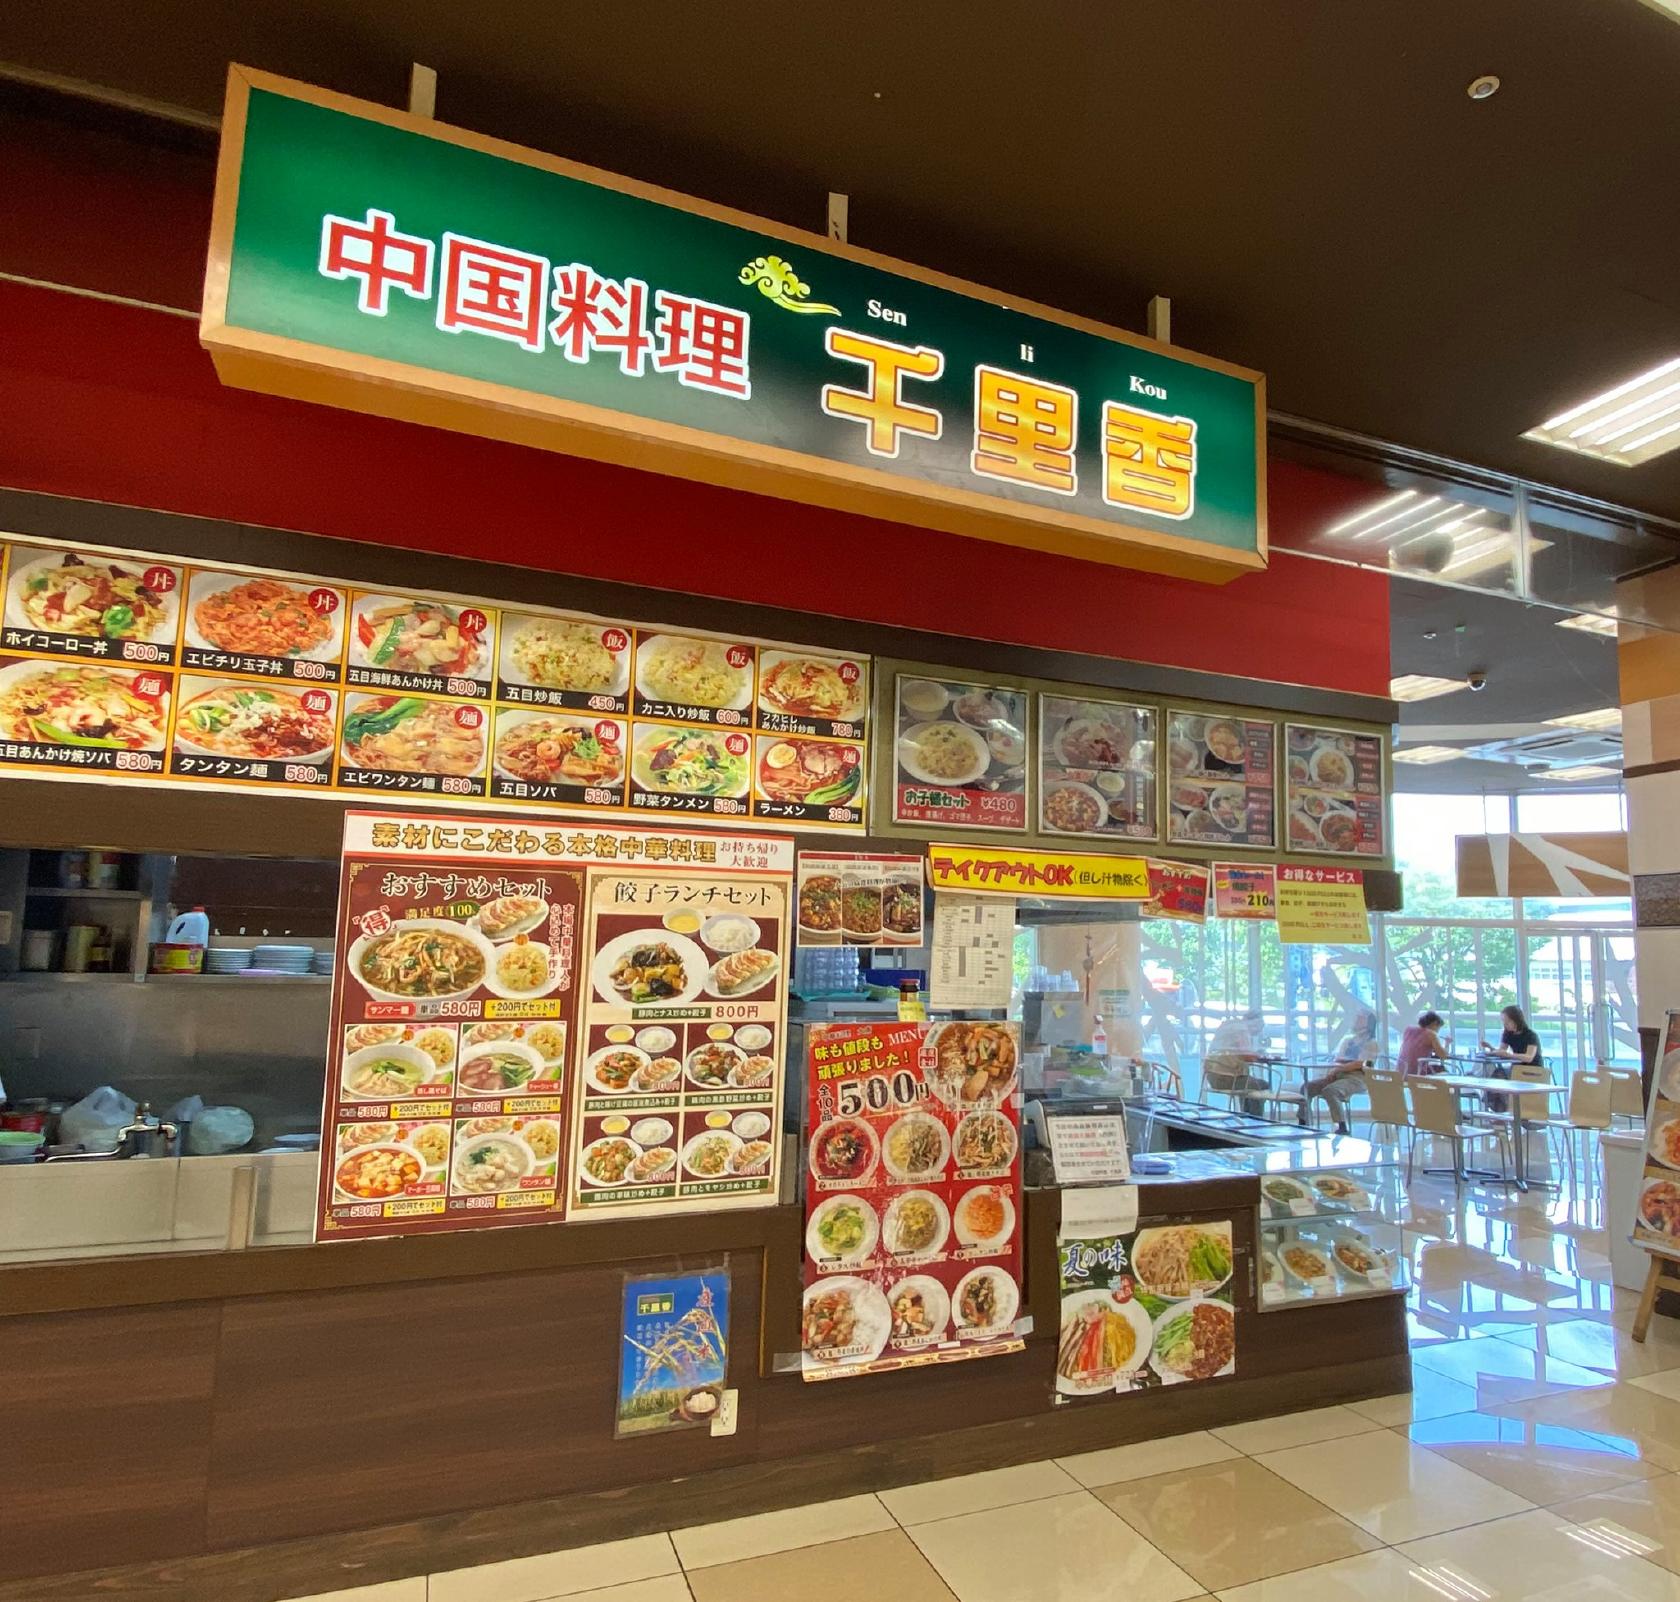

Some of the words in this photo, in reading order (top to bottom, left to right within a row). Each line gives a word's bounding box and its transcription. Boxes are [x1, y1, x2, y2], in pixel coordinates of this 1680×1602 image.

[319, 208, 752, 400] 中国料理
[867, 298, 908, 328] Sen
[1129, 375, 1168, 401] Kou
[822, 327, 1197, 521] 千里香
[152, 570, 174, 590] 丼
[314, 591, 336, 612] 丼
[5, 631, 109, 655] ホイコーロー丼
[122, 643, 171, 663] 500円
[186, 652, 284, 675] エビチリ玉子丼
[293, 660, 337, 681] 500円
[349, 669, 444, 691] 五目海鮮あんかけ丼
[447, 678, 487, 698] 500円
[505, 686, 563, 706] 五目炒飯
[587, 695, 625, 712] 450円
[641, 702, 711, 722] カニ入り炒飯
[716, 709, 749, 726] 600円
[762, 711, 798, 725] フカヒレ
[761, 721, 816, 736] あんかけ炒飯
[116, 752, 163, 770] 580円
[179, 757, 269, 778] タンタン麺
[285, 764, 328, 784] 580円
[344, 771, 436, 790] エビワンタン麺
[442, 778, 482, 794] 580円
[500, 781, 559, 798] 五目ソバ
[584, 787, 621, 805] 580円
[633, 792, 710, 811] 野菜タンメン
[713, 799, 747, 814] 580円
[759, 802, 807, 817] ラーメン
[371, 822, 718, 864] 素材にこだわる本格中華料理
[719, 841, 779, 855] お持ち帰り
[729, 854, 769, 869] 大歓迎
[933, 857, 1075, 886] テイクアウトOK
[380, 871, 553, 901] おすすめセット
[1282, 868, 1356, 883] お得なサービス
[614, 881, 772, 907] 餃子ランチセット
[440, 1000, 482, 1017] 580円
[715, 1005, 760, 1019] 800円
[814, 1036, 884, 1061] 味も値段も
[817, 1051, 910, 1080] 頑張りました!
[837, 1069, 930, 1118] 500円
[357, 1105, 389, 1119] 580円
[473, 1100, 501, 1114] 580円
[351, 1204, 382, 1217] 580円
[466, 1196, 496, 1209] 580円
[1062, 1239, 1129, 1279] 夏の味
